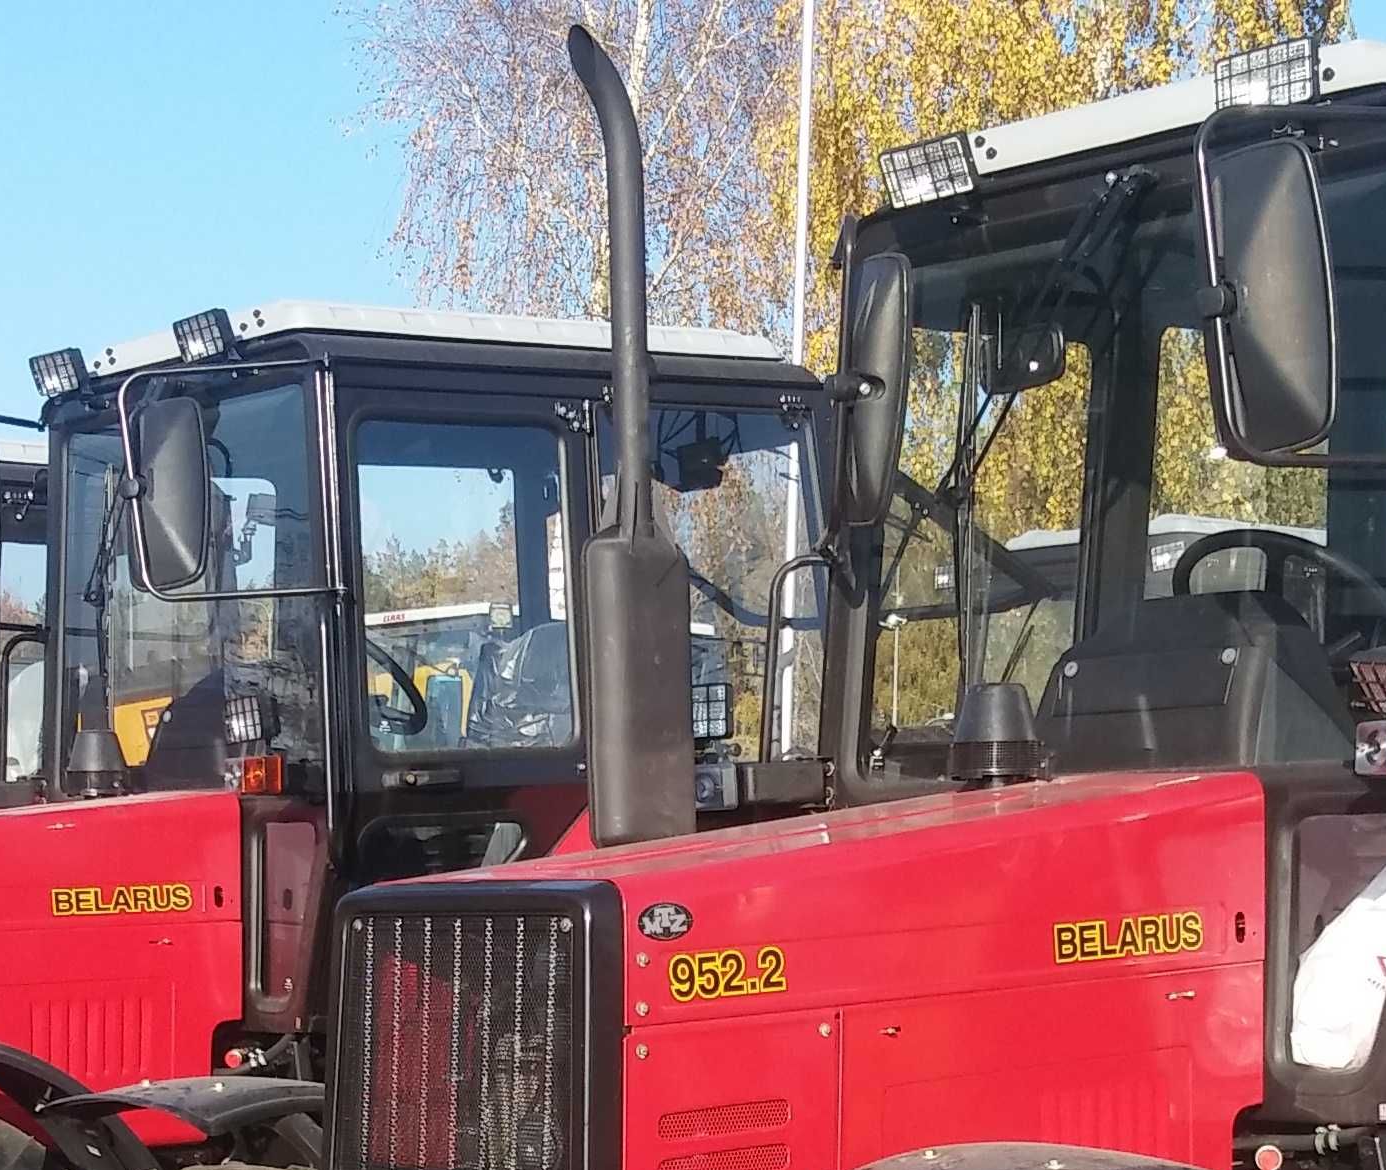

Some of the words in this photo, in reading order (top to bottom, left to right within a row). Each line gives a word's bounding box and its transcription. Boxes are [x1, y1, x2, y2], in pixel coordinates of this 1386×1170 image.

[51, 884, 192, 916] BELARUS
[641, 905, 688, 935] MTZ
[1053, 911, 1204, 963] BELARUS
[669, 946, 786, 1002] 952.2
